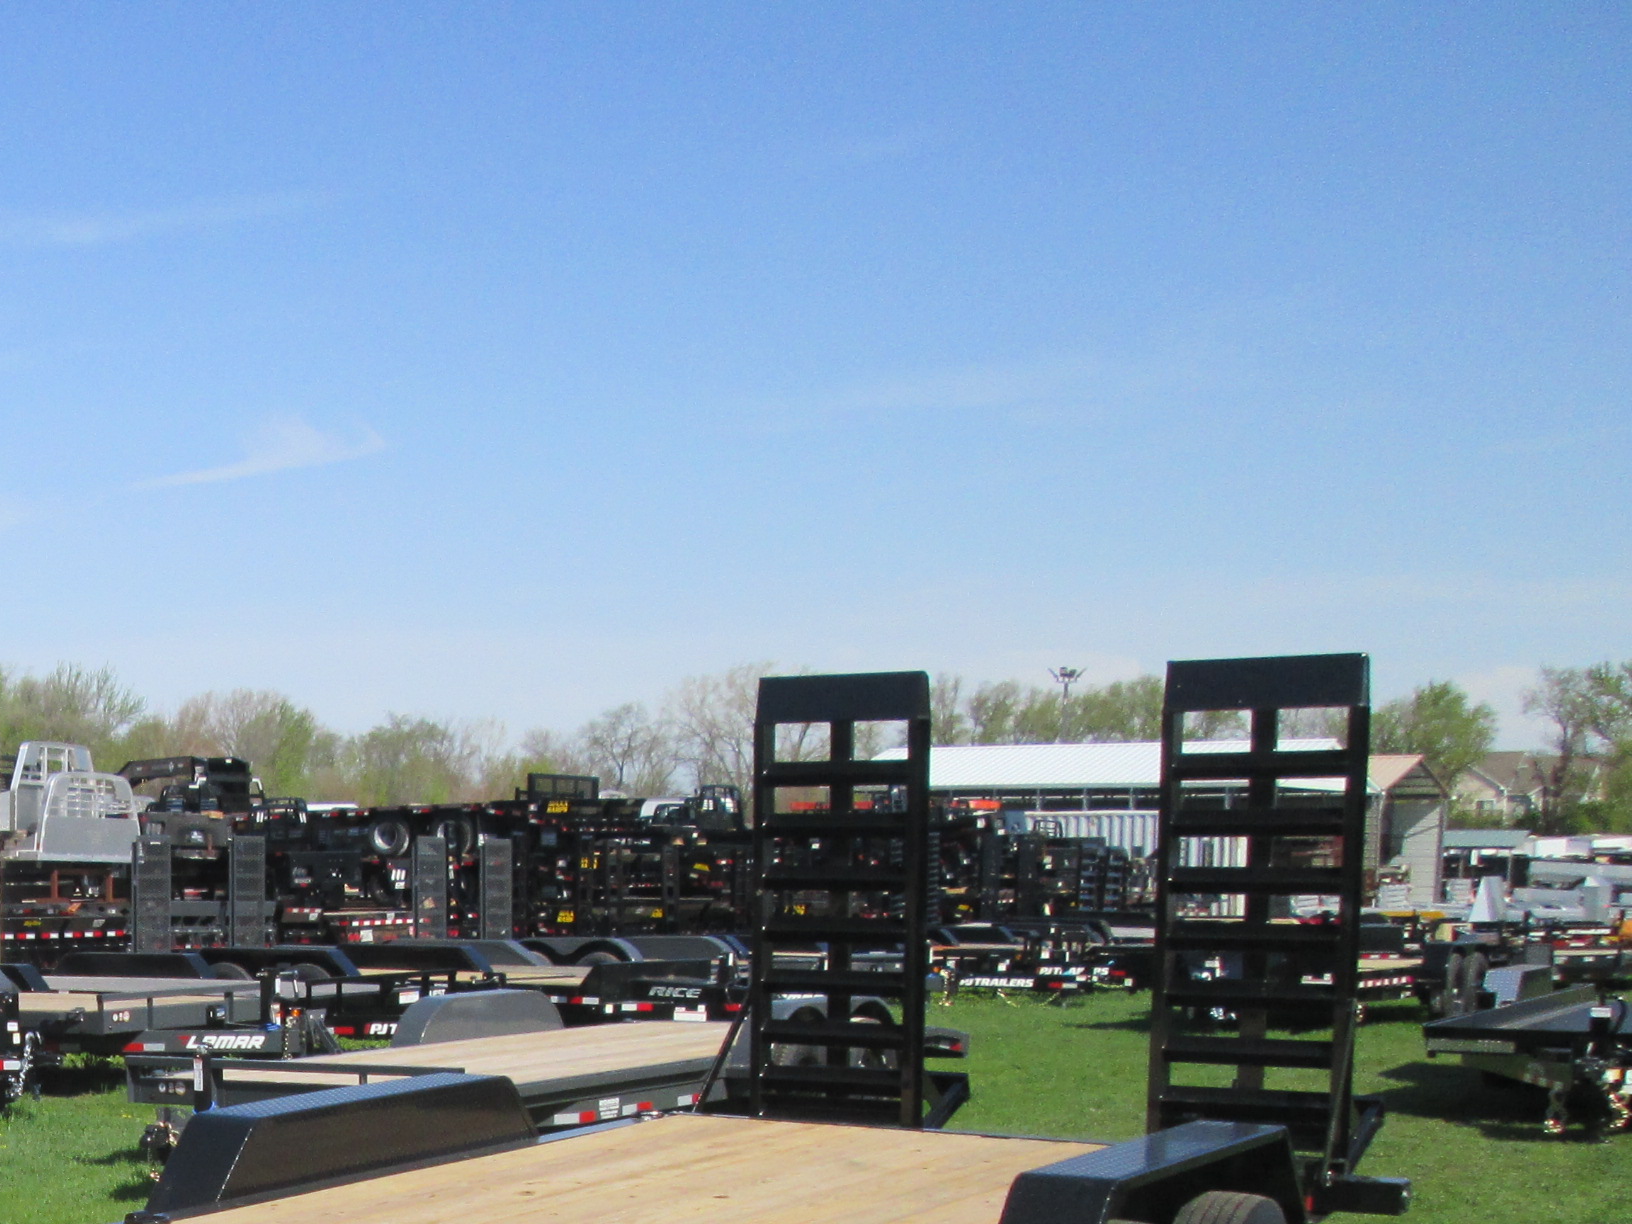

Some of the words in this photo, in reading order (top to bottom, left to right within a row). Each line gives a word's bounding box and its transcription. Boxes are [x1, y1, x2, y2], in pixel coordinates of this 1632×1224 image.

[974, 978, 1035, 988] TRAILERS
[648, 986, 702, 998] RICE
[186, 1035, 266, 1050] LAMAR
